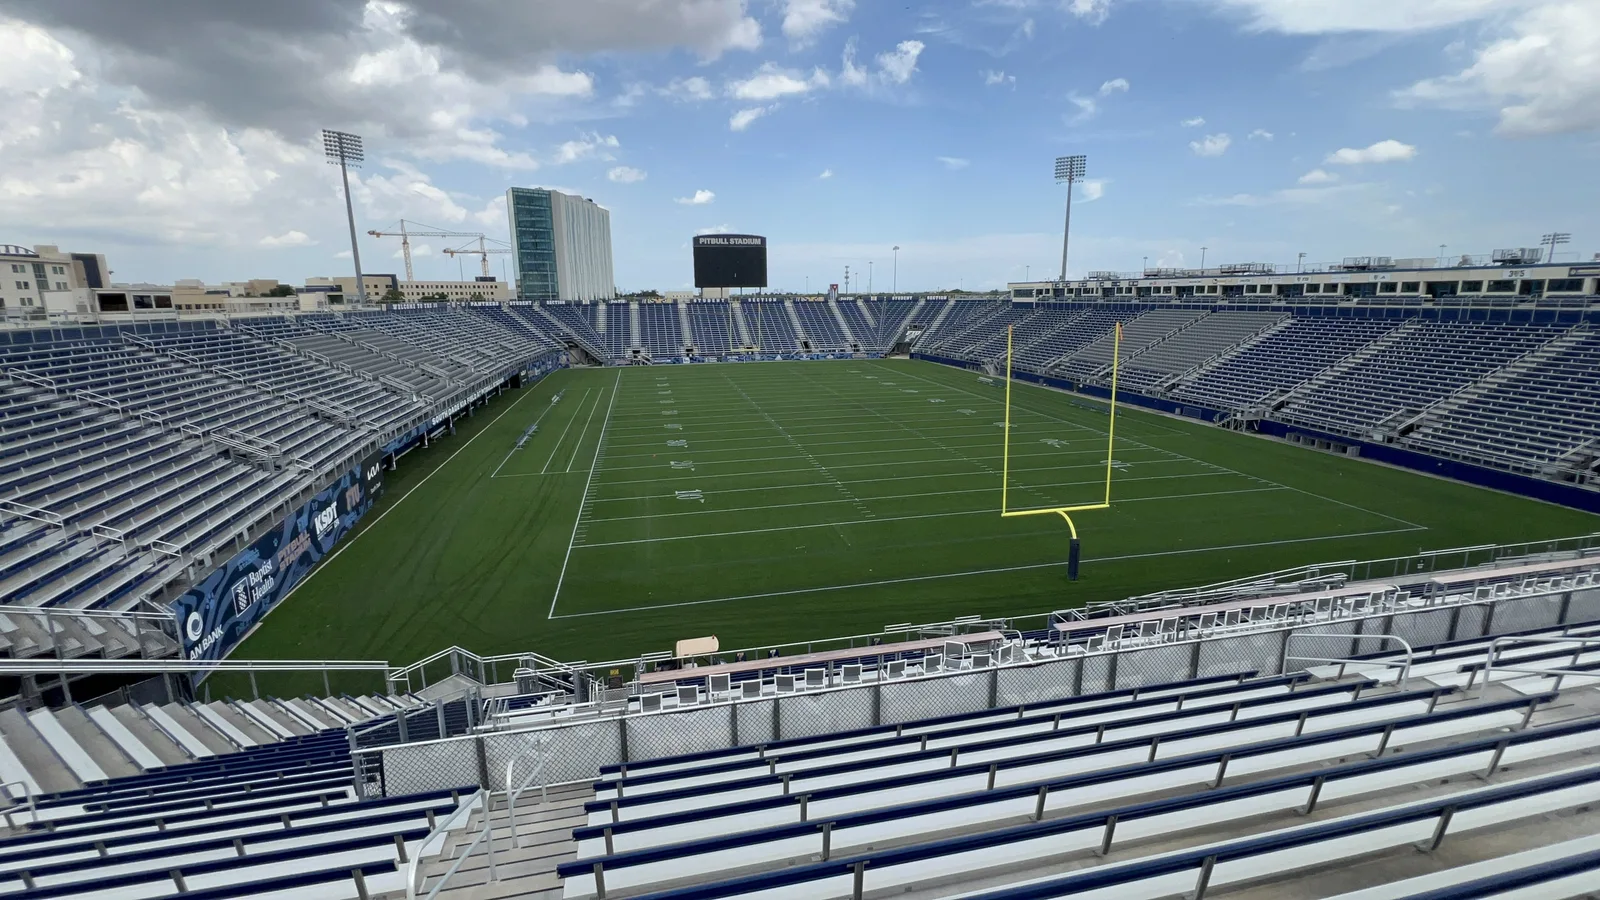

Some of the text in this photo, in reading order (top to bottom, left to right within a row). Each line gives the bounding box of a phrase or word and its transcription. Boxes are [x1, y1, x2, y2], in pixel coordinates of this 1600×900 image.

[699, 237, 729, 245] PITBULL
[314, 501, 337, 535] KSDT
[278, 529, 310, 562] PITBULL
[280, 538, 311, 571] STADIUM
[249, 559, 273, 587] Baptist
[251, 576, 275, 603] Health
[201, 624, 224, 651] BANK
